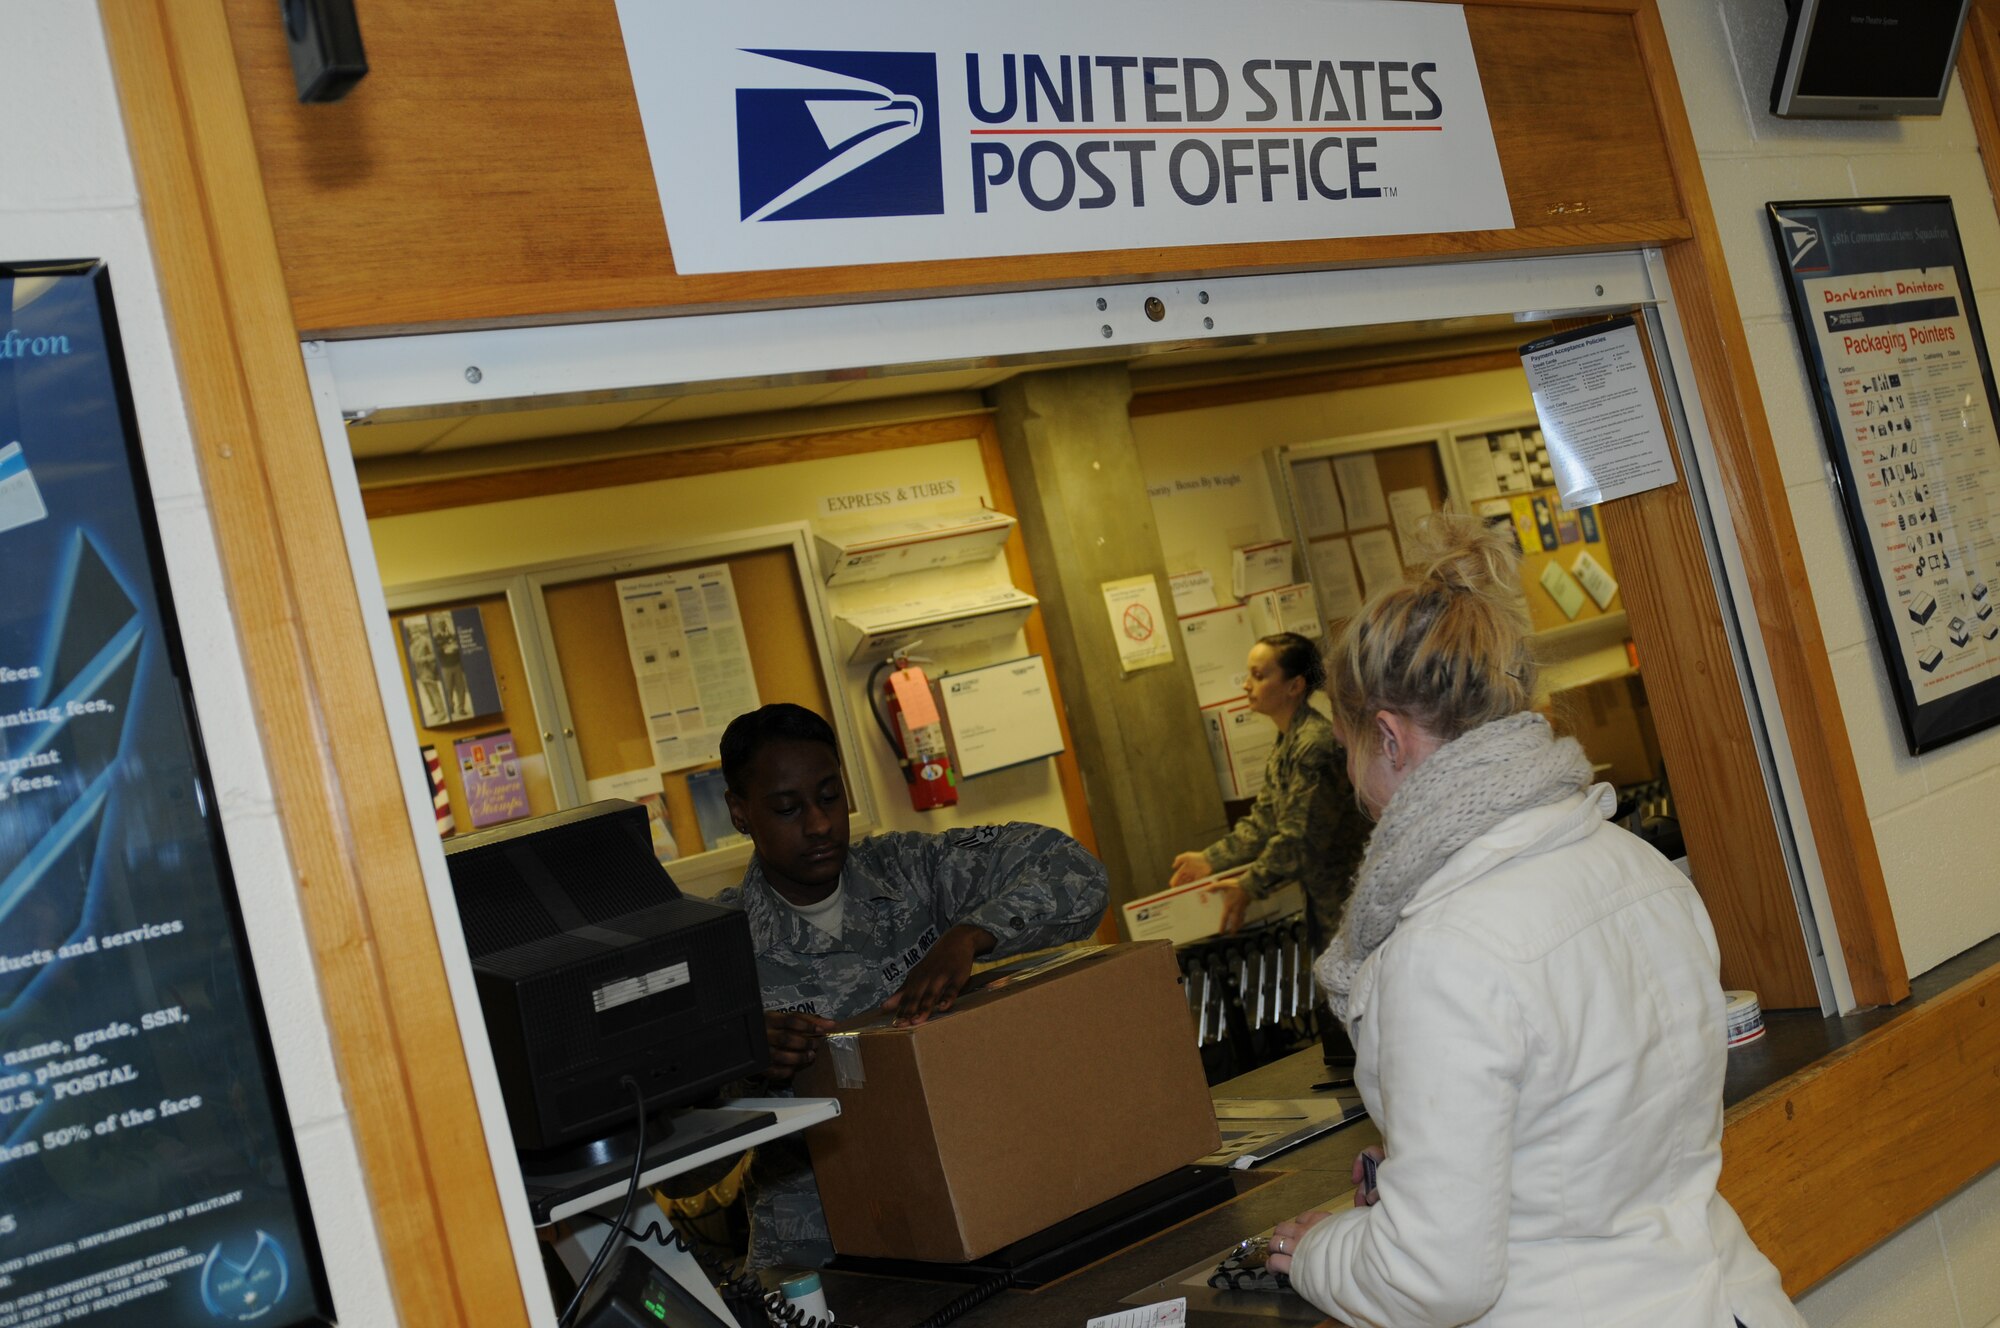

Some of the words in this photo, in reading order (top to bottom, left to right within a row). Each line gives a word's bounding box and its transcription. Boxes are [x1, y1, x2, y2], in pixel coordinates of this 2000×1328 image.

[966, 52, 1229, 124] UNITED
[1244, 58, 1443, 122] STATES
[971, 139, 1156, 214] POST
[1168, 136, 1382, 206] OFFICE
[1915, 226, 1950, 245] Squadron
[1530, 350, 1554, 362] Payment
[1554, 342, 1585, 355] Acceptance
[1585, 336, 1607, 346] Policies
[1844, 330, 1908, 355] Packaging
[1909, 324, 1956, 346] Pointers
[827, 490, 891, 512] EXPRESS
[896, 487, 908, 502] &
[911, 479, 956, 500] TUBES
[0, 666, 42, 683] fees
[66, 700, 116, 717] fees,
[11, 774, 62, 793] fees.
[58, 935, 99, 959] and
[101, 919, 184, 949] services
[882, 962, 903, 981] U.S.
[903, 948, 921, 969] AIR
[3, 1040, 71, 1065] name,
[74, 1021, 138, 1052] grade,
[141, 1006, 190, 1031] SSN,
[35, 1053, 108, 1086] phone.
[53, 1064, 139, 1101] POSTAL
[42, 1123, 92, 1150] 50%
[94, 1113, 119, 1135] of
[120, 1107, 156, 1128] the
[159, 1095, 202, 1118] face
[78, 1213, 168, 1250] IMPLEMENTED
[168, 1208, 186, 1223] BY
[186, 1190, 243, 1218] MILITARY
[17, 1291, 47, 1308] FOR
[46, 1259, 146, 1300] NONSUFFICIENT
[146, 1245, 190, 1268] FUNDS.
[22, 1305, 43, 1321] DO
[43, 1294, 73, 1314] NOT
[72, 1286, 104, 1305] GIVE
[104, 1277, 132, 1294] THE
[132, 1252, 208, 1286] REQUESTED
[63, 1303, 92, 1321] YOU
[92, 1278, 171, 1312] REQUESTED.
